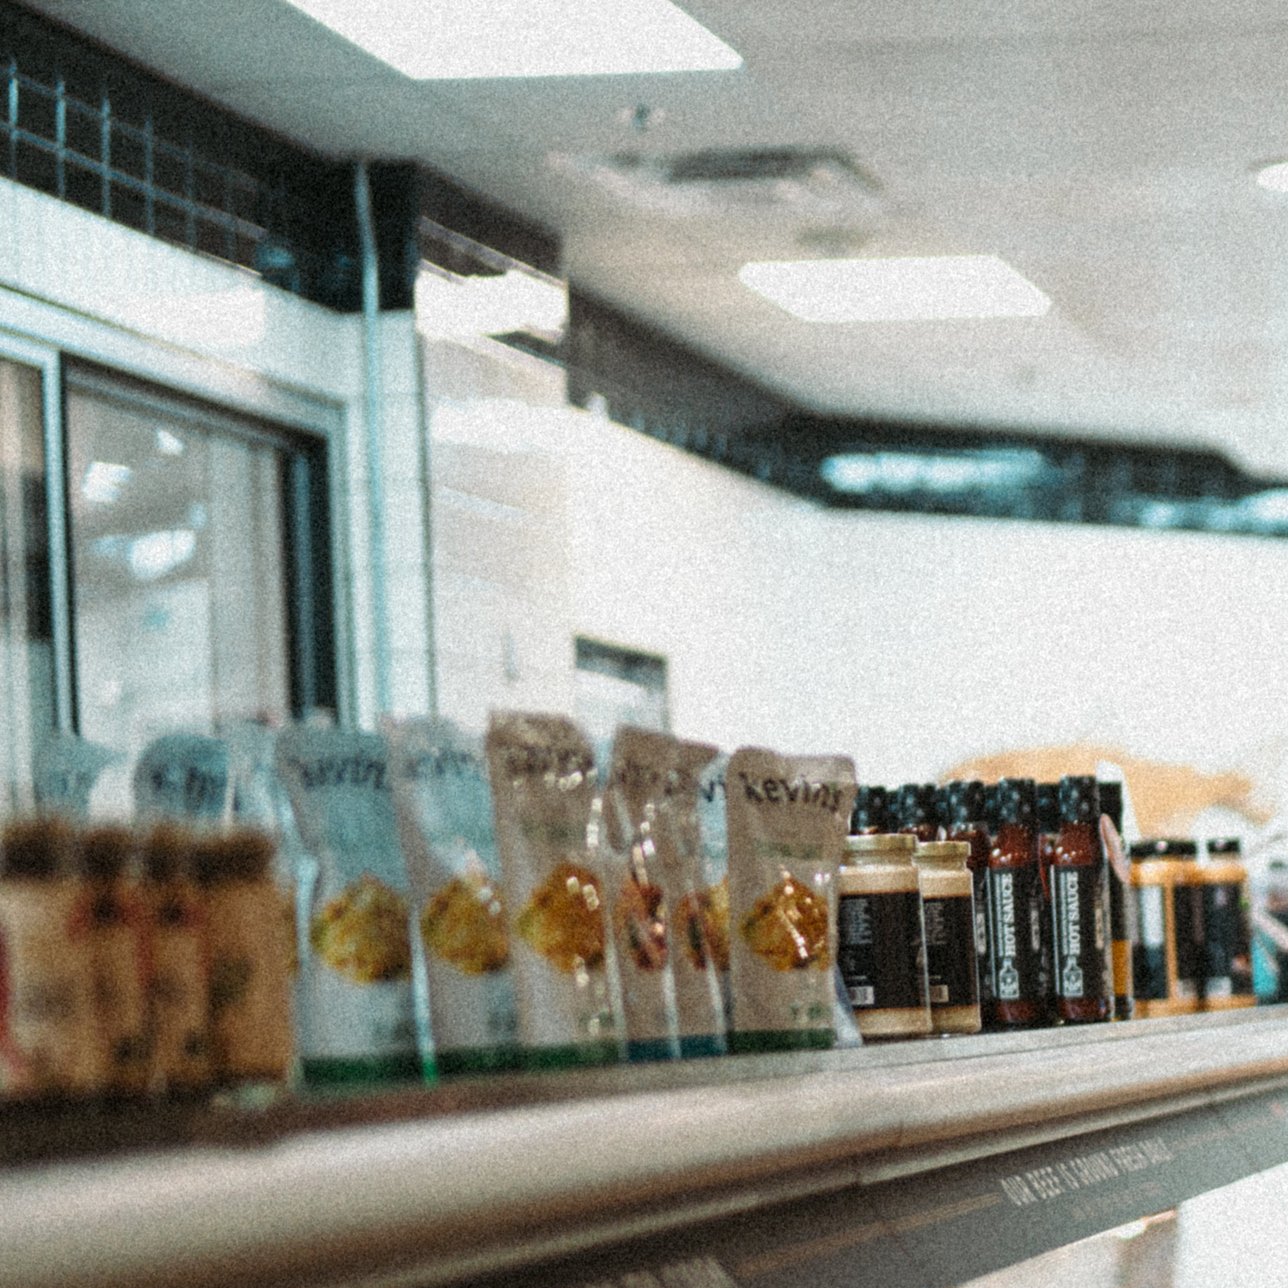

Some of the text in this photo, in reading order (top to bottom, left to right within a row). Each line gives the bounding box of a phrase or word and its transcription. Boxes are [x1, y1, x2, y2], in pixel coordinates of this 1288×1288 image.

[1001, 873, 1017, 957] HOT SAUCE
[1065, 872, 1081, 956] HOT SAUCE
